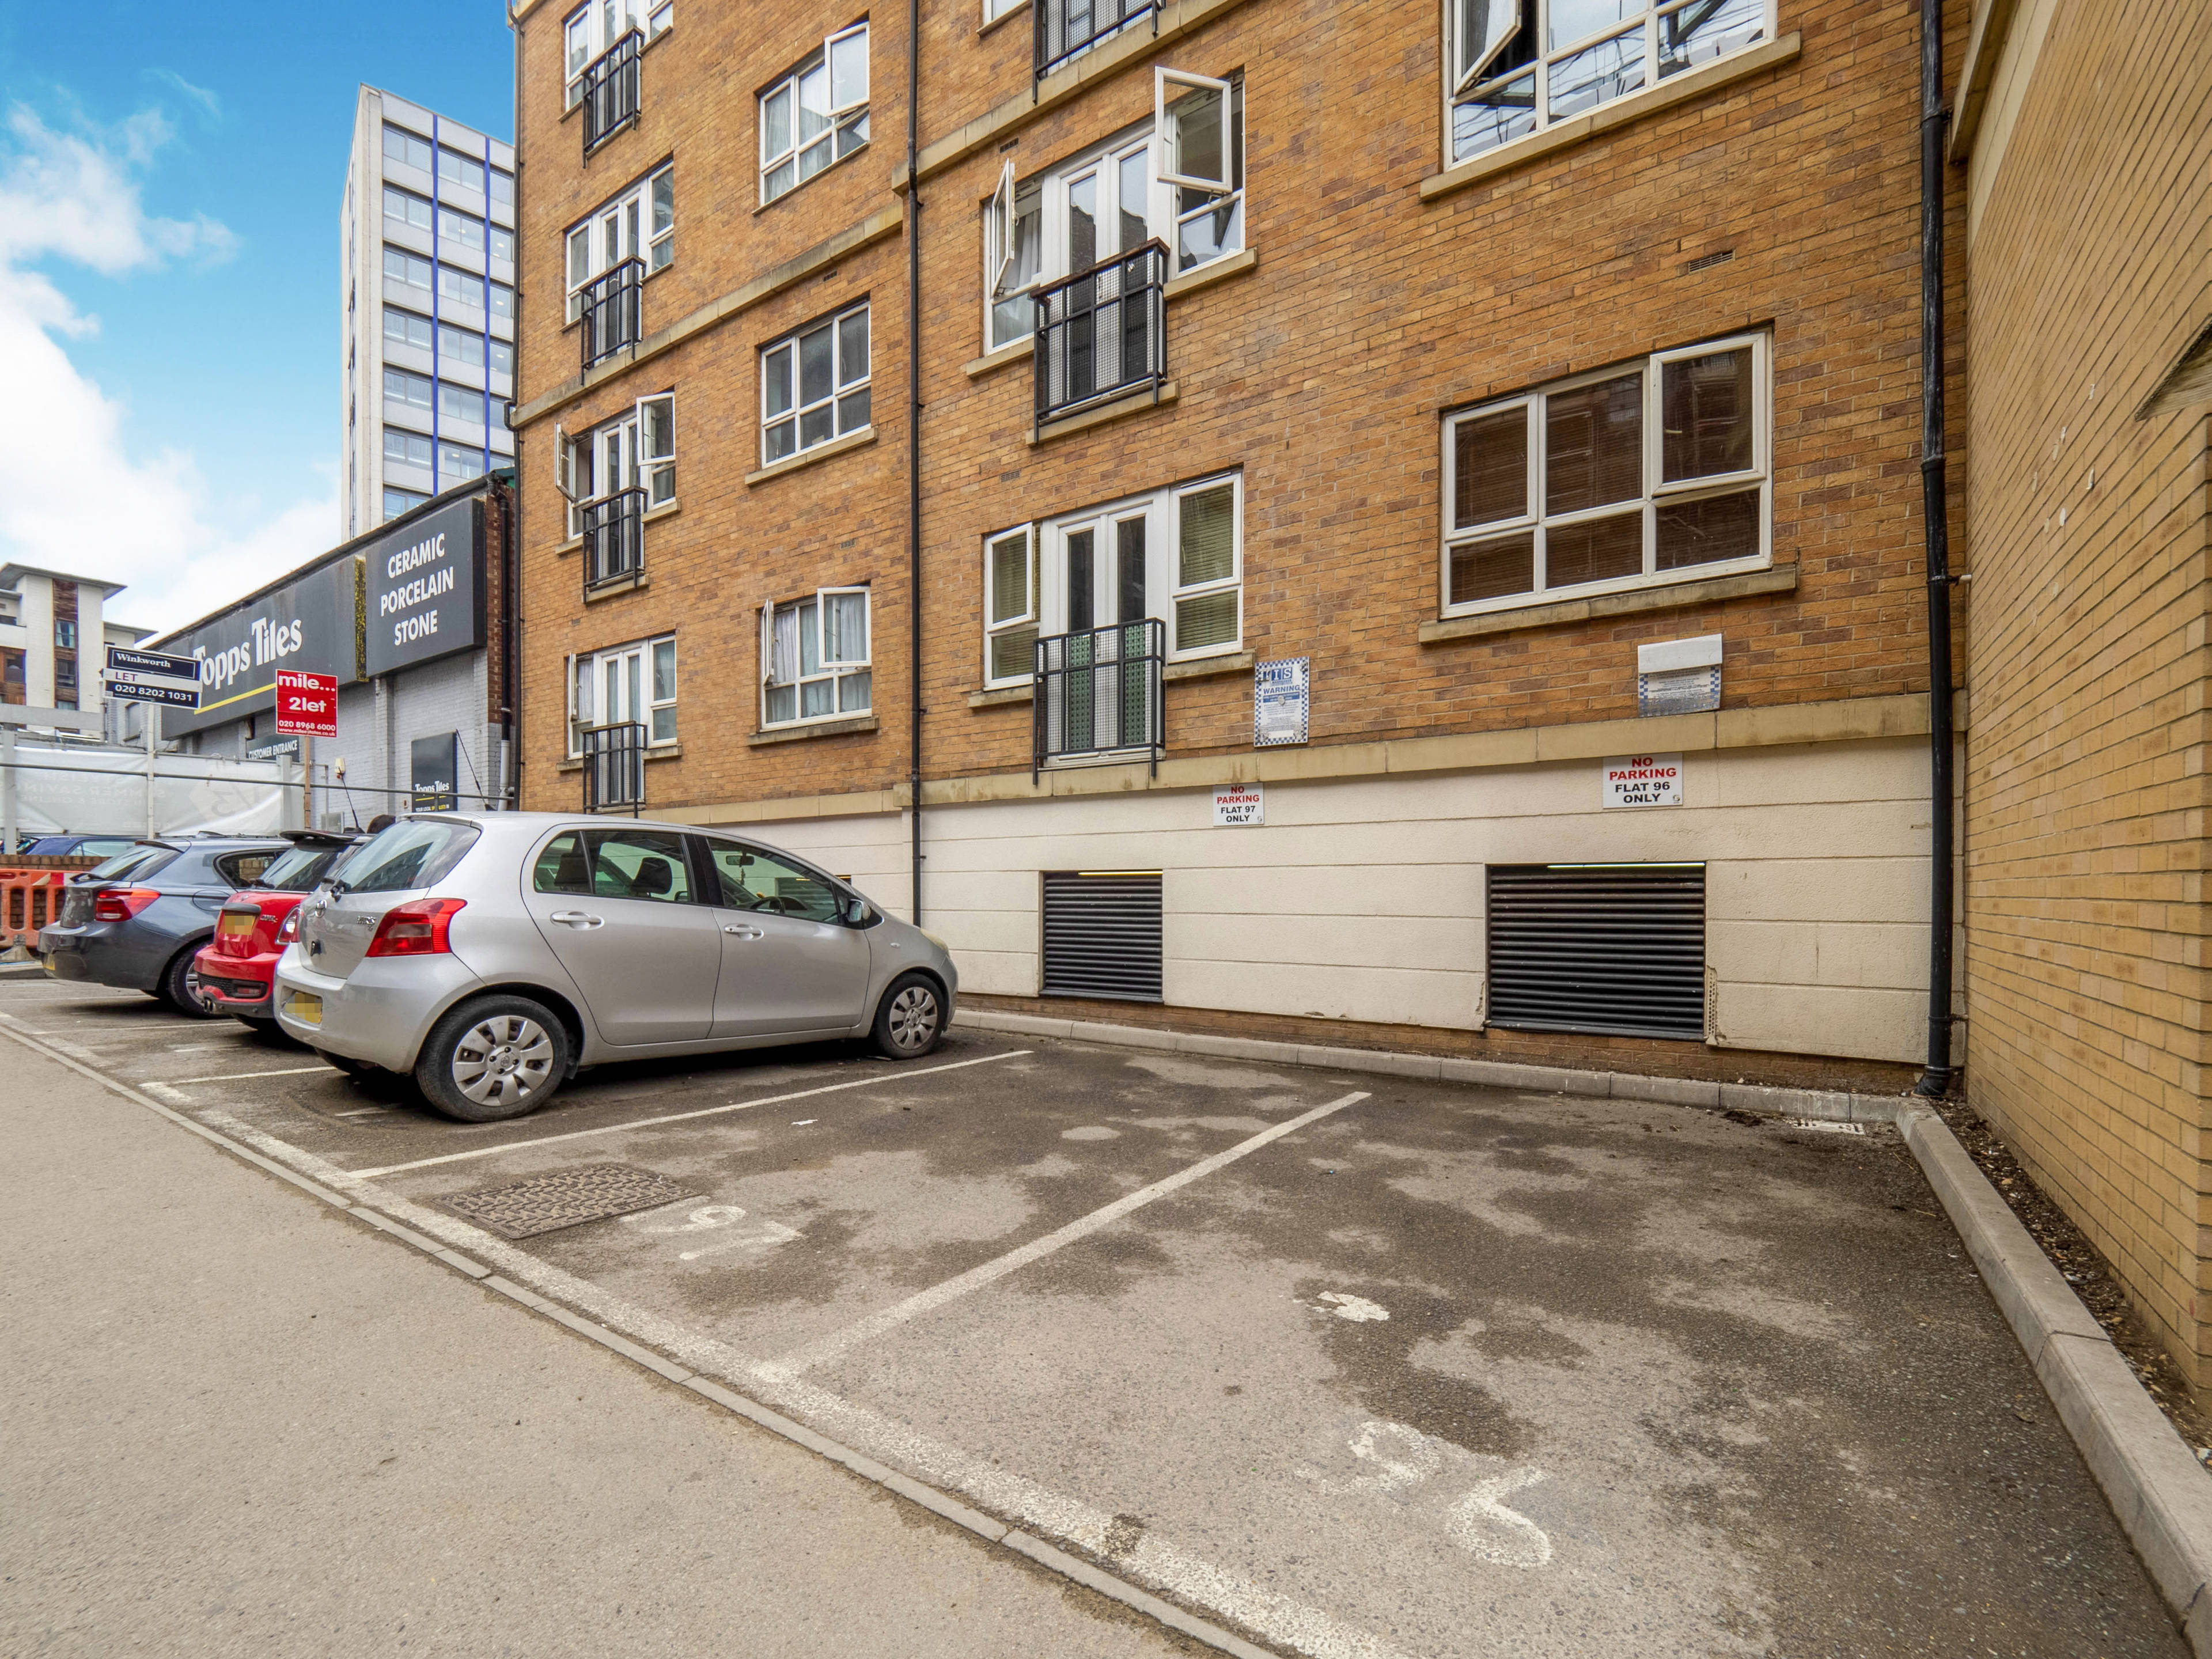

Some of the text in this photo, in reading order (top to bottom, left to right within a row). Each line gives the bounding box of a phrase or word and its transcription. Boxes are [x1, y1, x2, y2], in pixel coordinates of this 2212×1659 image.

[388, 533, 445, 578] CERAMIC
[381, 566, 454, 617] PORCELAIN
[394, 609, 438, 646] STONE
[251, 617, 302, 666] Tiles
[116, 653, 171, 668] Winkworth
[115, 672, 138, 681] LET
[115, 684, 136, 694] 020
[138, 687, 165, 698] 8202
[168, 692, 193, 702] 1031
[1263, 684, 1300, 695] WARNING
[289, 697, 327, 713] 2let
[296, 721, 316, 730] 8968
[317, 724, 336, 732] 6000
[249, 740, 298, 759] CUSTOMER ENTRANCE
[1632, 757, 1653, 767] NO
[1609, 768, 1676, 781] PARKING
[434, 781, 449, 792] Tiles
[1231, 786, 1245, 794] NO
[1615, 782, 1670, 793] FLAT 96
[1217, 794, 1259, 804] PARKING
[1623, 793, 1661, 803] ONLY
[1226, 815, 1249, 823] ONLY
